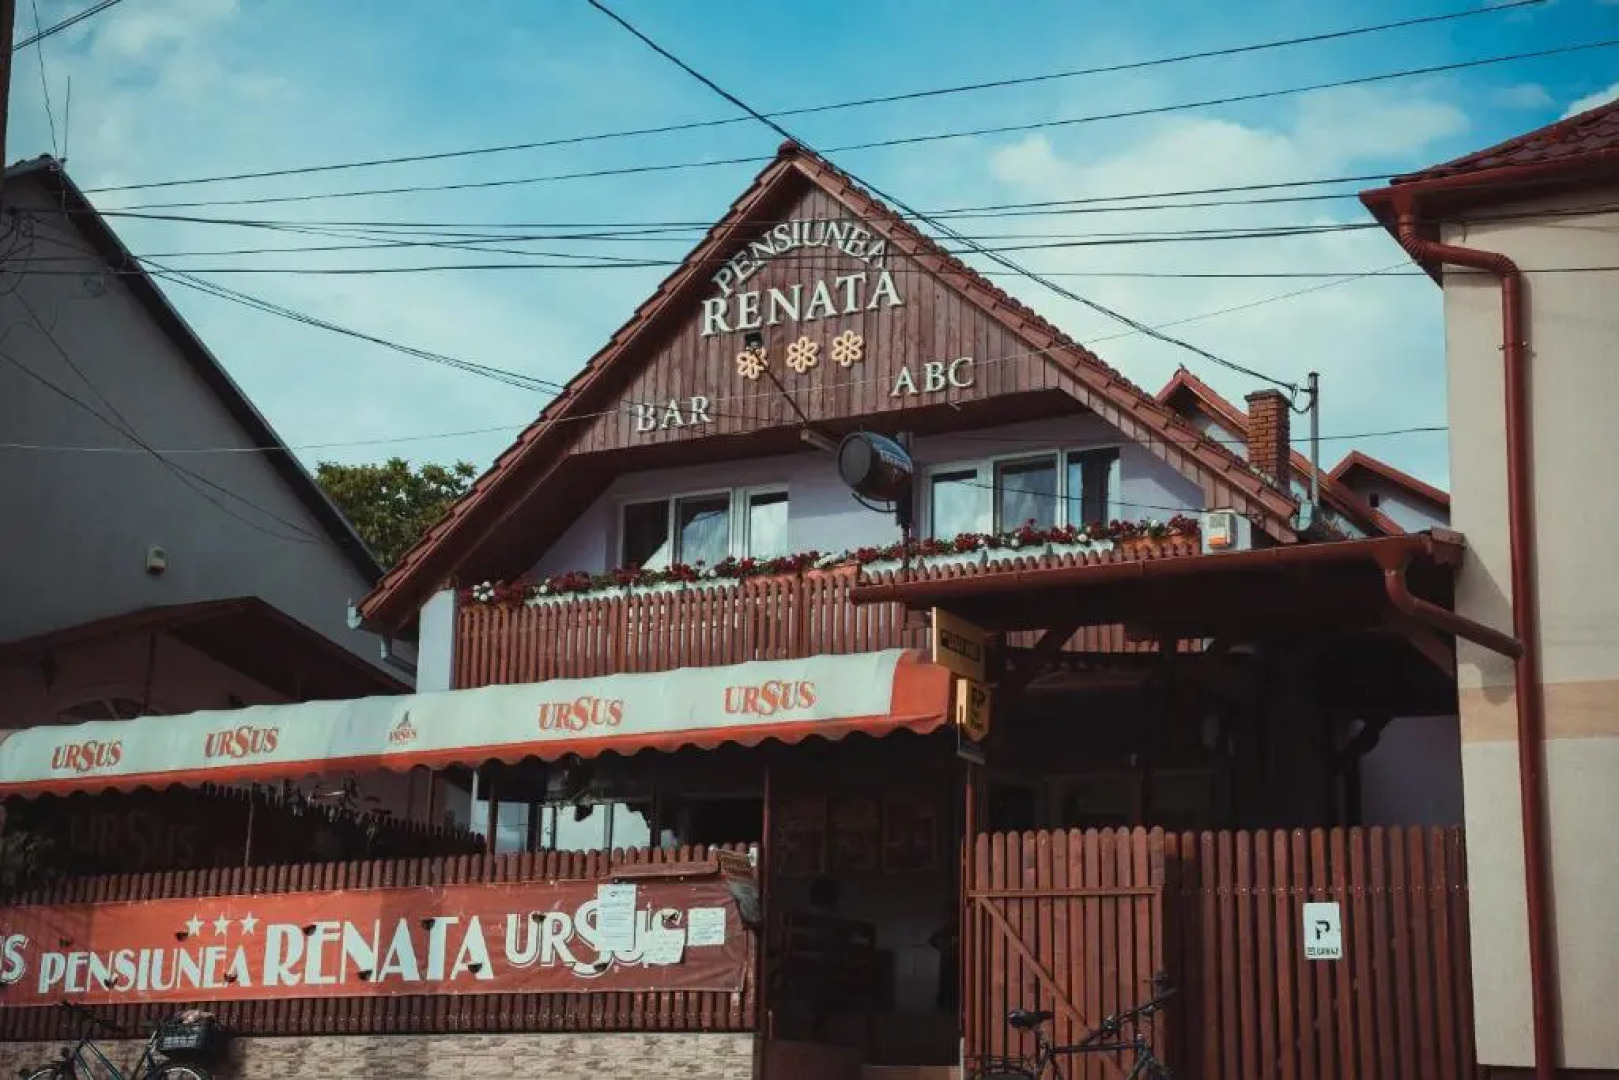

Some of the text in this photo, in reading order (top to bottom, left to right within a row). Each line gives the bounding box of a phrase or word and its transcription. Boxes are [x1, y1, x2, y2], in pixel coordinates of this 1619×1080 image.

[711, 218, 888, 297] PENSIUNEA
[701, 270, 904, 337] RENATA
[890, 356, 975, 397] ABC
[636, 396, 713, 432] BAR
[538, 695, 624, 733] URSUS
[723, 679, 817, 717] URSUS
[51, 739, 124, 774] URSUS
[203, 725, 280, 760] URSUS
[37, 945, 252, 994] PENSIUNEA
[262, 915, 495, 987] RENATA
